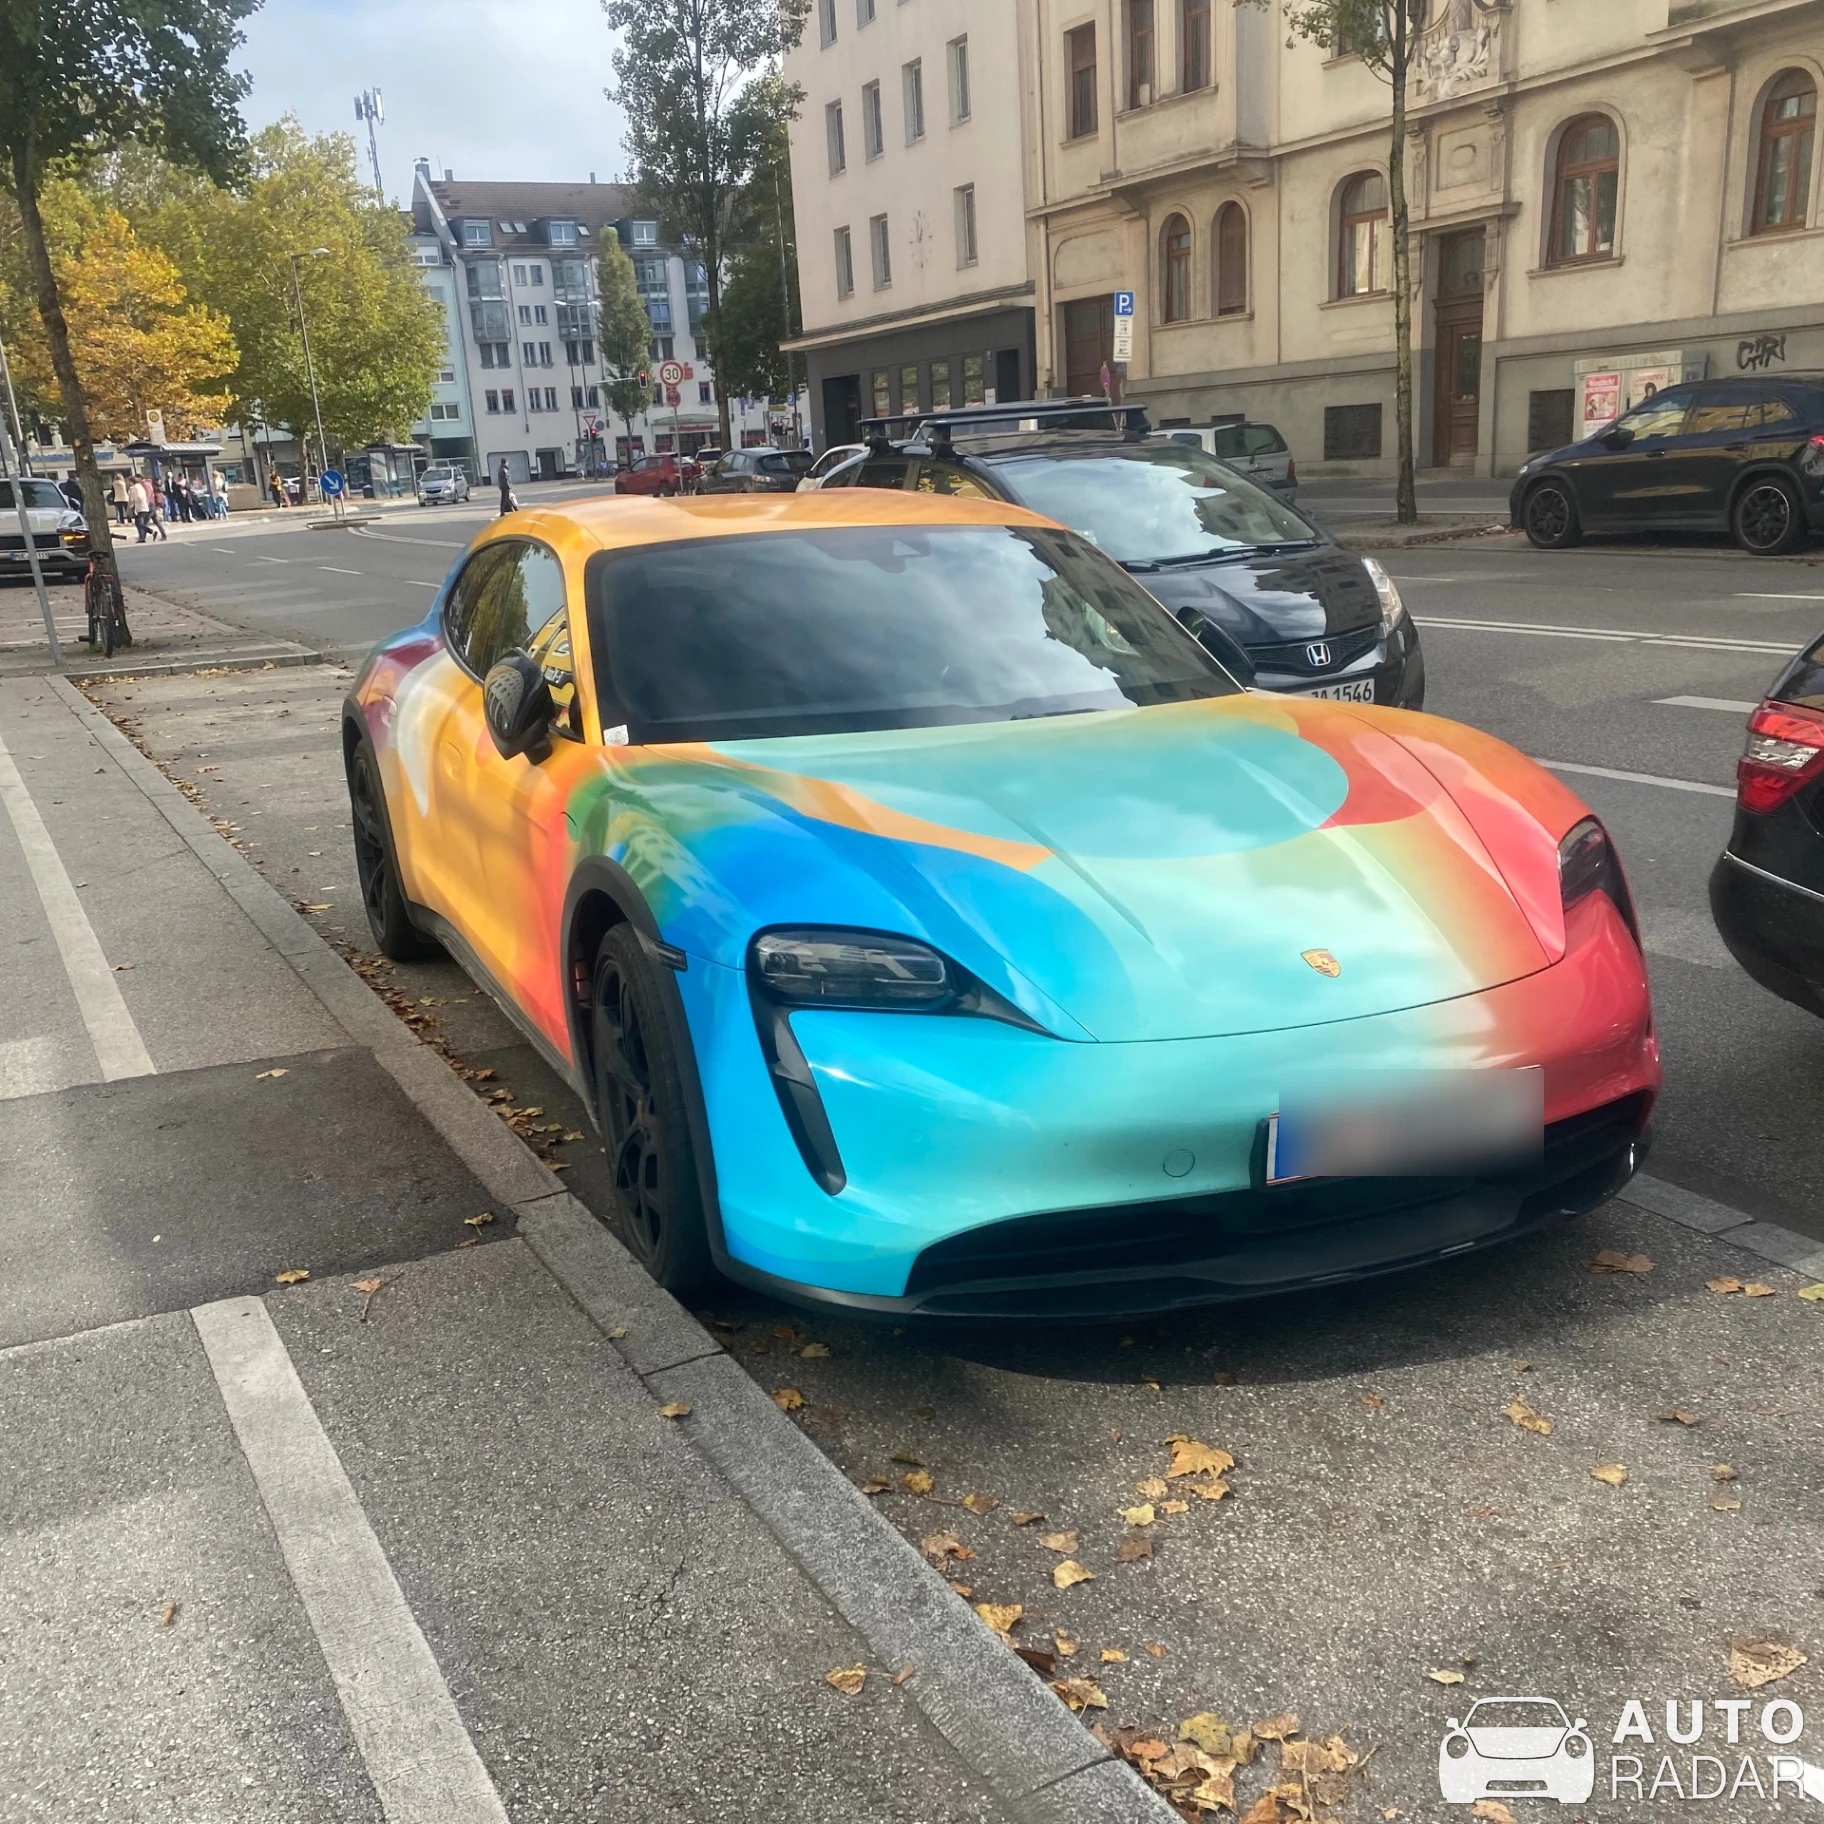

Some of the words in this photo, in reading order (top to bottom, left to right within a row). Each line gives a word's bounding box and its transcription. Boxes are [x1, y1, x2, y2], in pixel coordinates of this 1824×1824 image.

[1118, 294, 1130, 313] P
[665, 368, 679, 380] 30
[1333, 681, 1372, 702] 1546
